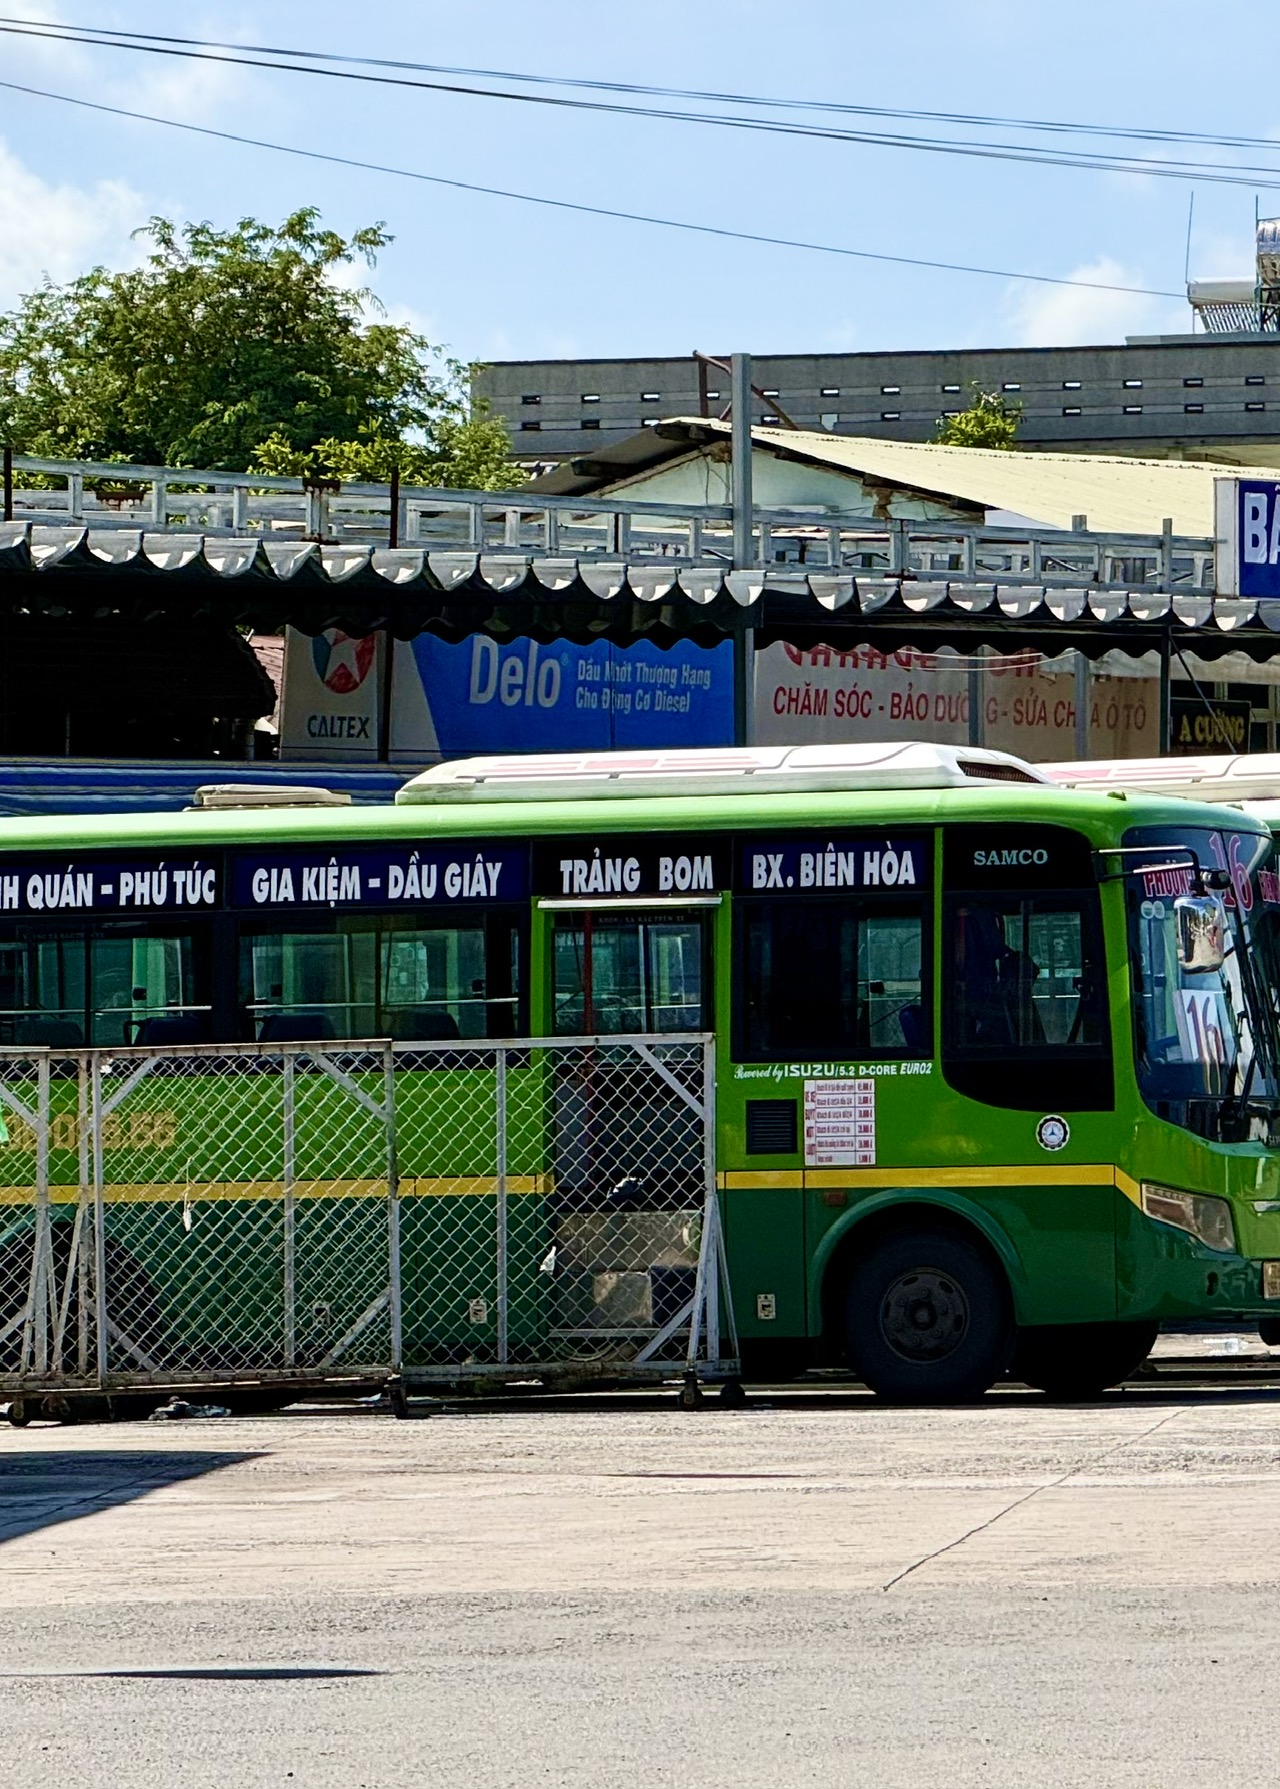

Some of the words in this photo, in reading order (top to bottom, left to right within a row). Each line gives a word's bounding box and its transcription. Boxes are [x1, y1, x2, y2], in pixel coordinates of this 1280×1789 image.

[470, 634, 561, 708] Delo
[577, 657, 601, 682] Dầu
[635, 662, 678, 690] Thượng
[681, 664, 711, 691] Hạng
[576, 687, 598, 710] Cho
[635, 689, 651, 711] Cơ
[654, 690, 691, 713] Diesel
[773, 681, 828, 717] CHĂM
[834, 680, 873, 719] SÓC
[889, 682, 928, 721] BẢO
[1012, 686, 1048, 726] SỬA
[1054, 700, 1100, 728] CHA
[307, 715, 370, 739] CALTEX
[1178, 713, 1192, 742] A
[252, 867, 295, 904] GIA
[301, 857, 361, 907] KIỆM
[388, 851, 437, 899] DẦU
[444, 853, 502, 898] GIÂY
[559, 847, 640, 893] TRẢNG
[658, 855, 714, 891] BOM
[752, 853, 793, 890] BX.
[800, 842, 854, 887] BIÊN
[863, 841, 916, 886] HÒA
[973, 849, 1048, 867] SAMCO
[1209, 831, 1254, 911] 16
[26, 865, 93, 910] QUÁN
[119, 862, 168, 906] PHÚ
[174, 861, 215, 905] TÚC
[734, 1065, 771, 1080] Powered
[772, 1064, 785, 1083] by
[859, 1065, 898, 1076] D-CORE
